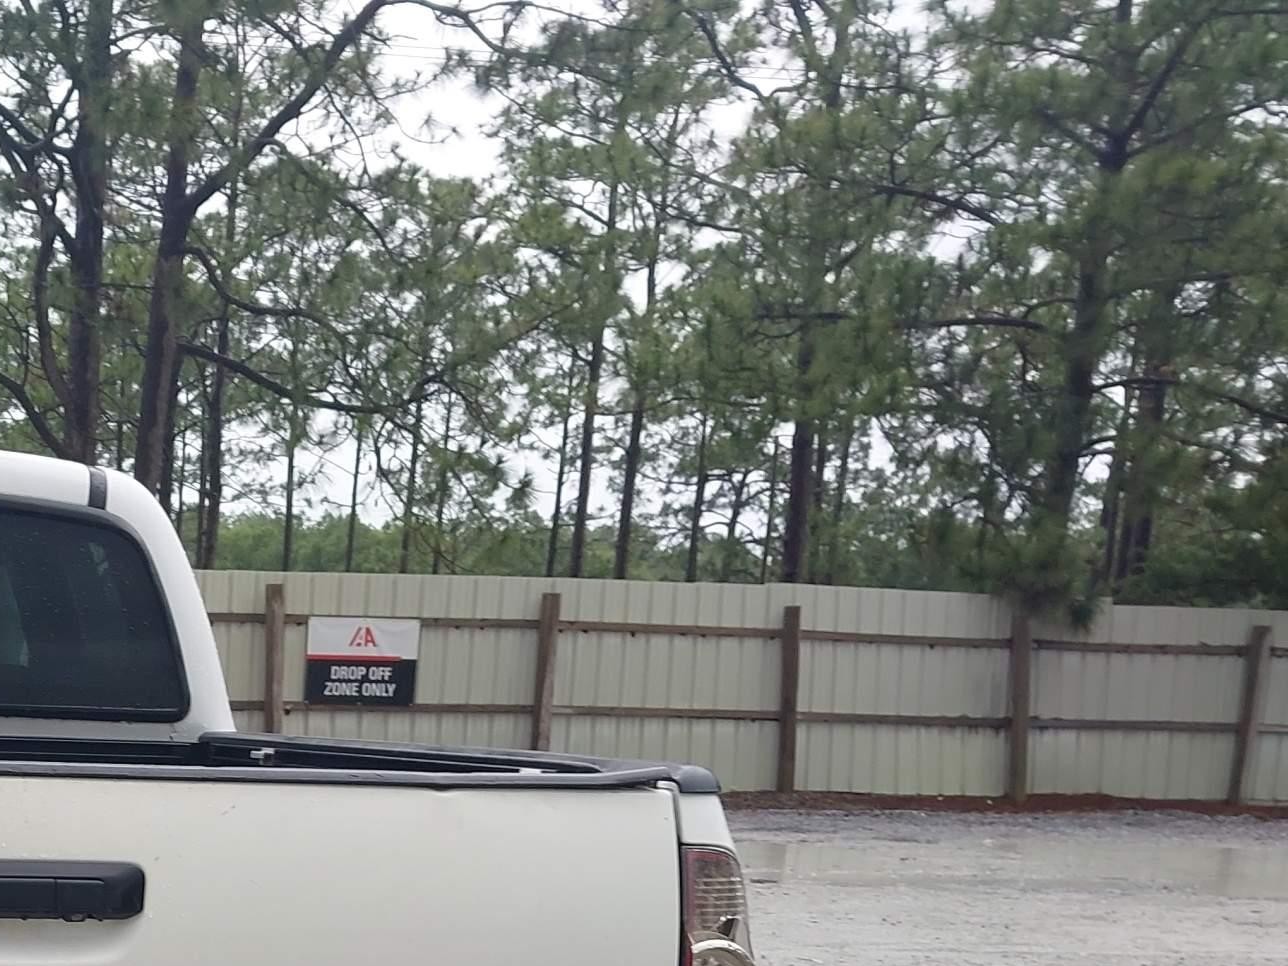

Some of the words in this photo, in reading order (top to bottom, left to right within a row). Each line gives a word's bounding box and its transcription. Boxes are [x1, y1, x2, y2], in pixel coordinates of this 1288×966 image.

[330, 665, 367, 680] DROP
[368, 666, 393, 681] OFF
[323, 682, 360, 696] ZONE
[362, 682, 397, 697] ONLY
